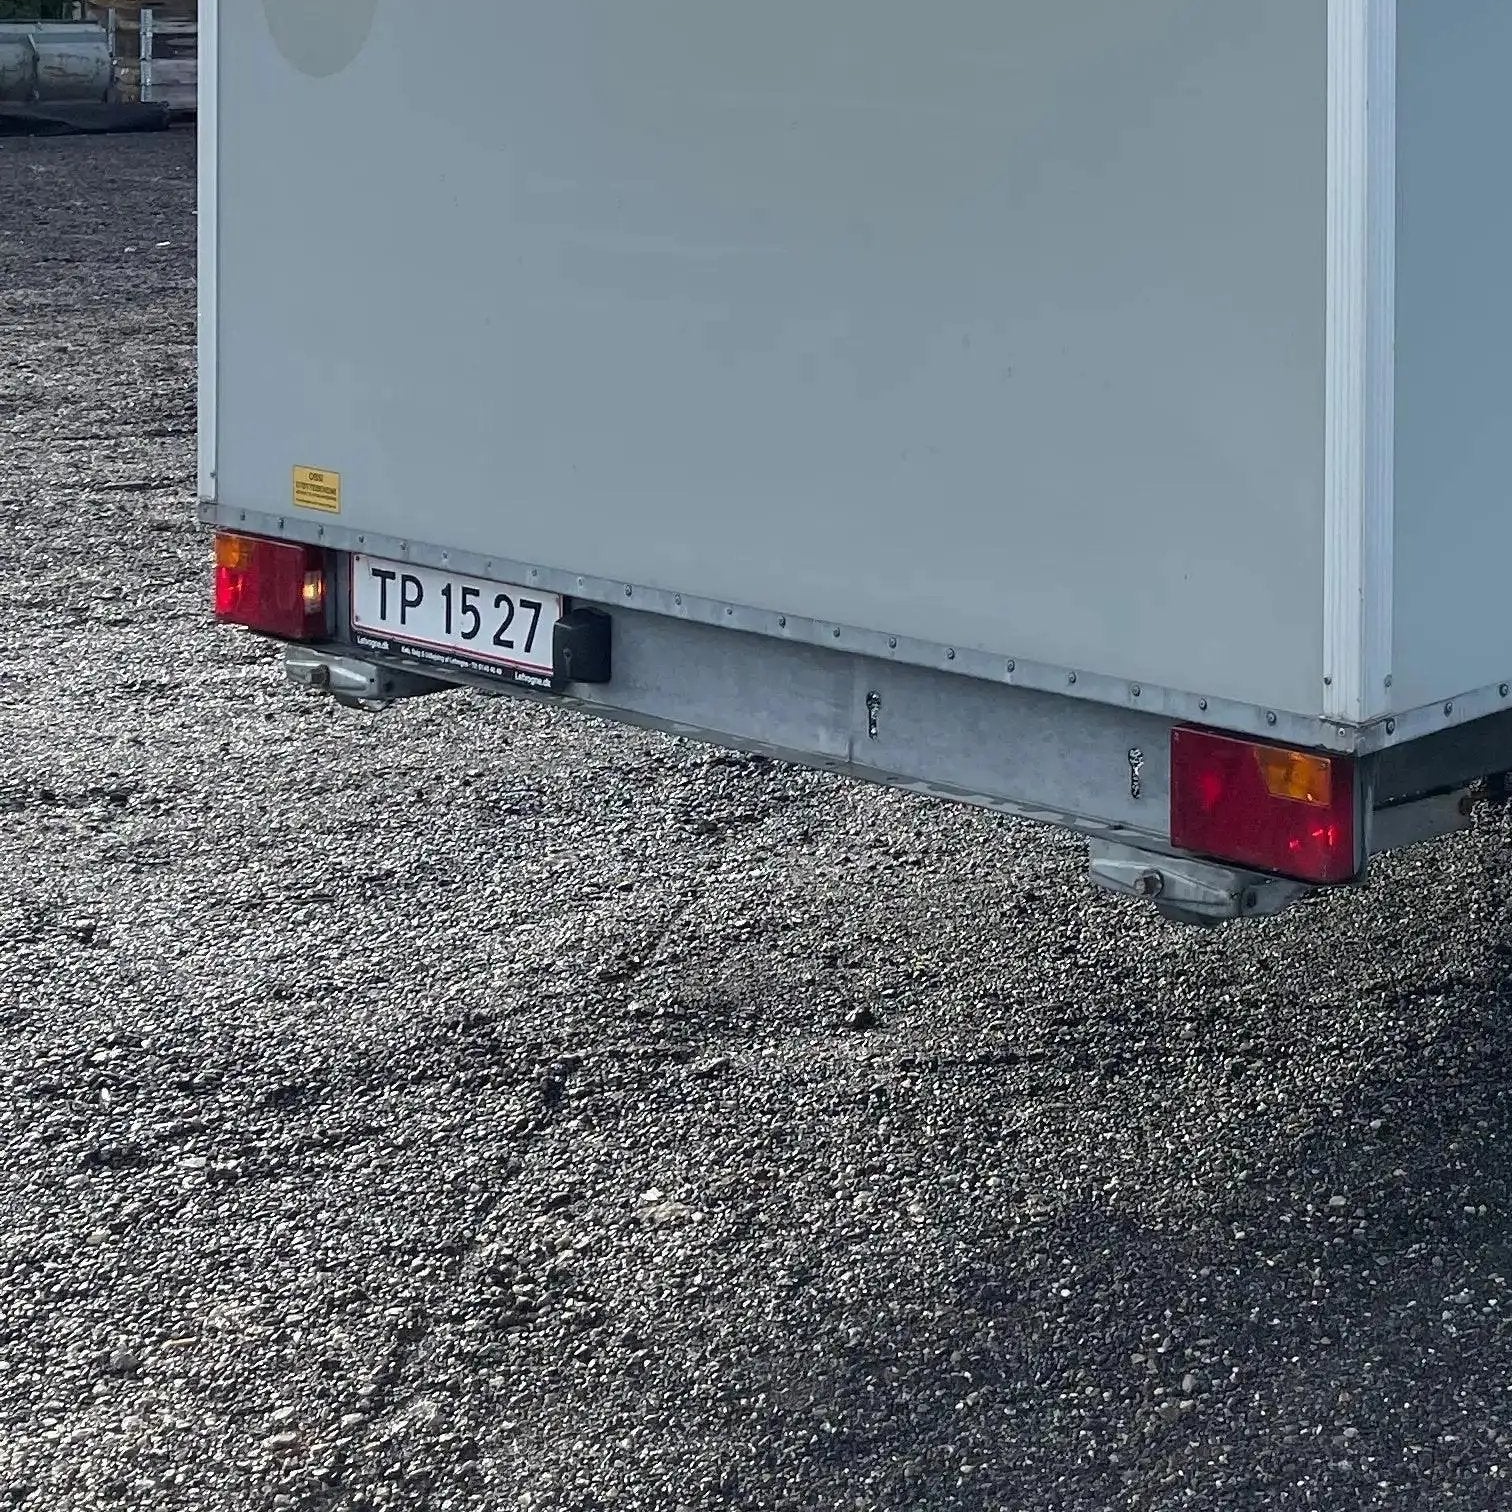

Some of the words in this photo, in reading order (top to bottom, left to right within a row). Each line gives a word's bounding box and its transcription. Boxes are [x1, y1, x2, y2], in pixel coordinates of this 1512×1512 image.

[371, 568, 424, 625] TP
[441, 583, 480, 640] 15
[493, 593, 542, 653] 27
